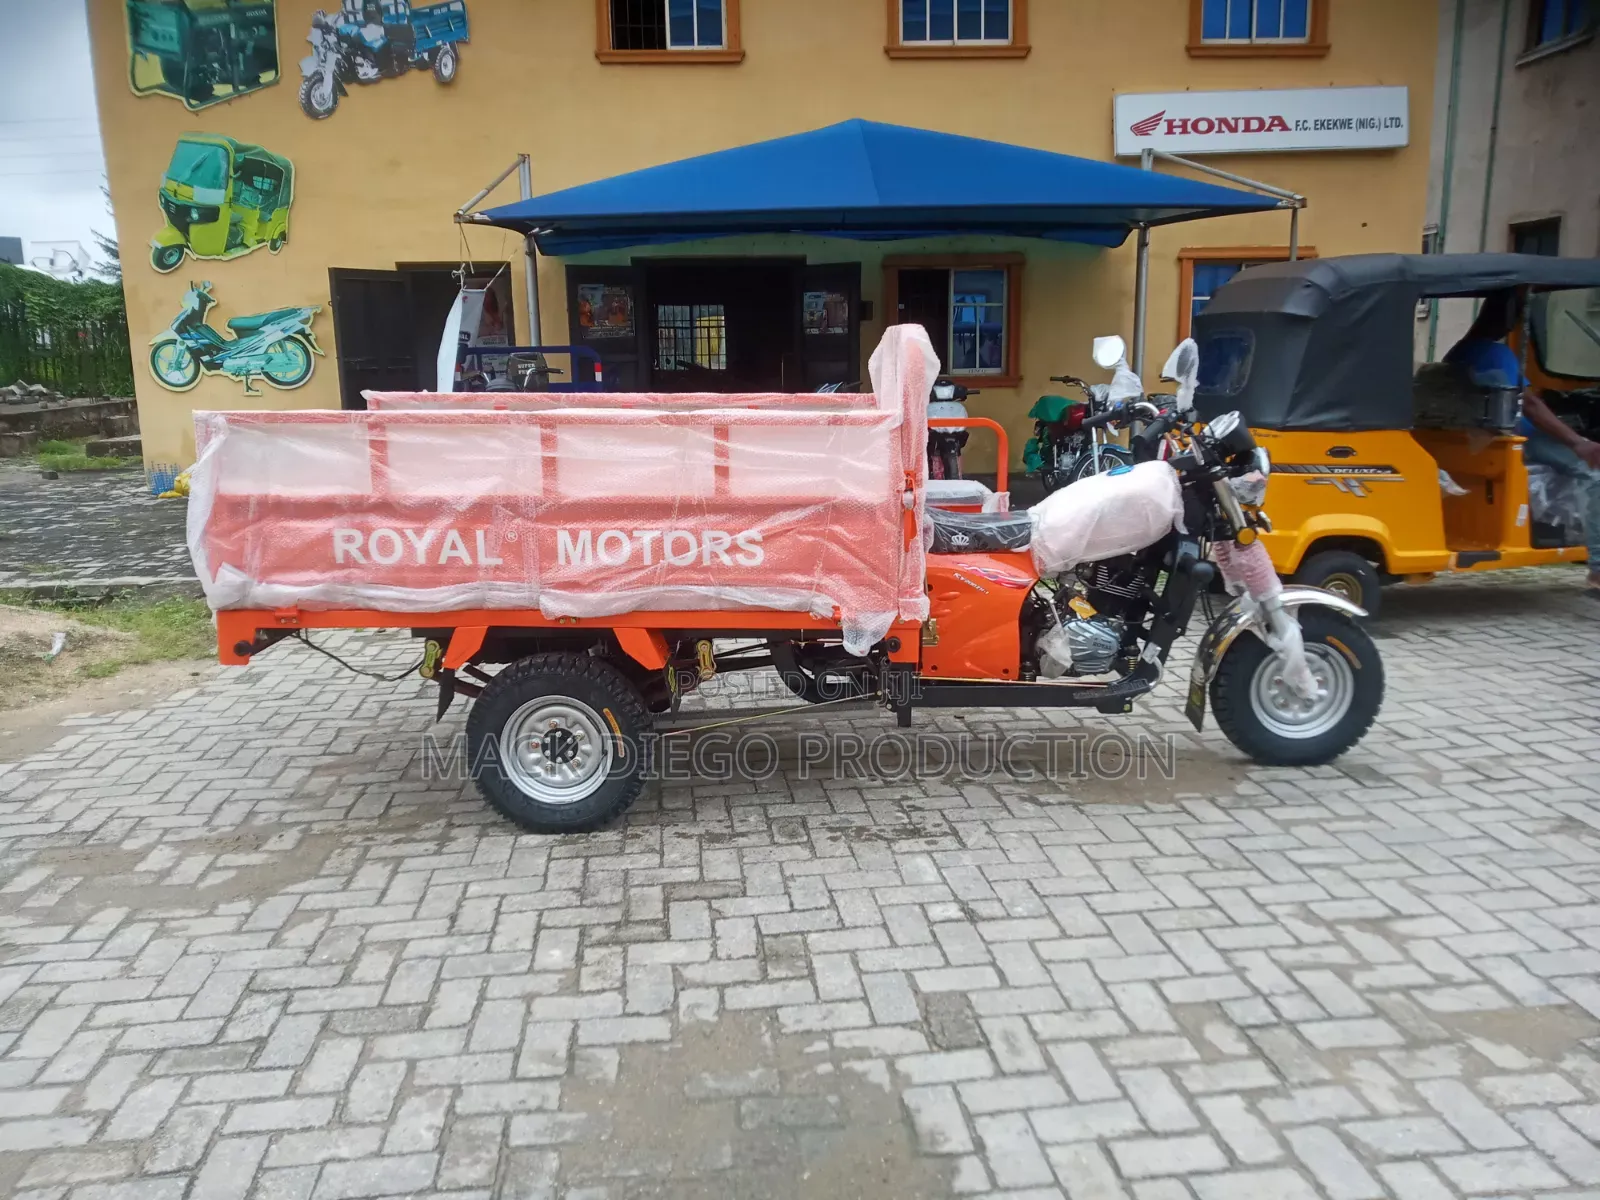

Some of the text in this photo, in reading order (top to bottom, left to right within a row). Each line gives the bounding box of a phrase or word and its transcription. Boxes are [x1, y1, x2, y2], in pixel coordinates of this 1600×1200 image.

[1163, 115, 1404, 135] HONDA F.C. EKEKWE (NIG.) LTD.
[333, 529, 503, 565] ROYAL
[556, 529, 765, 567] MOTORS
